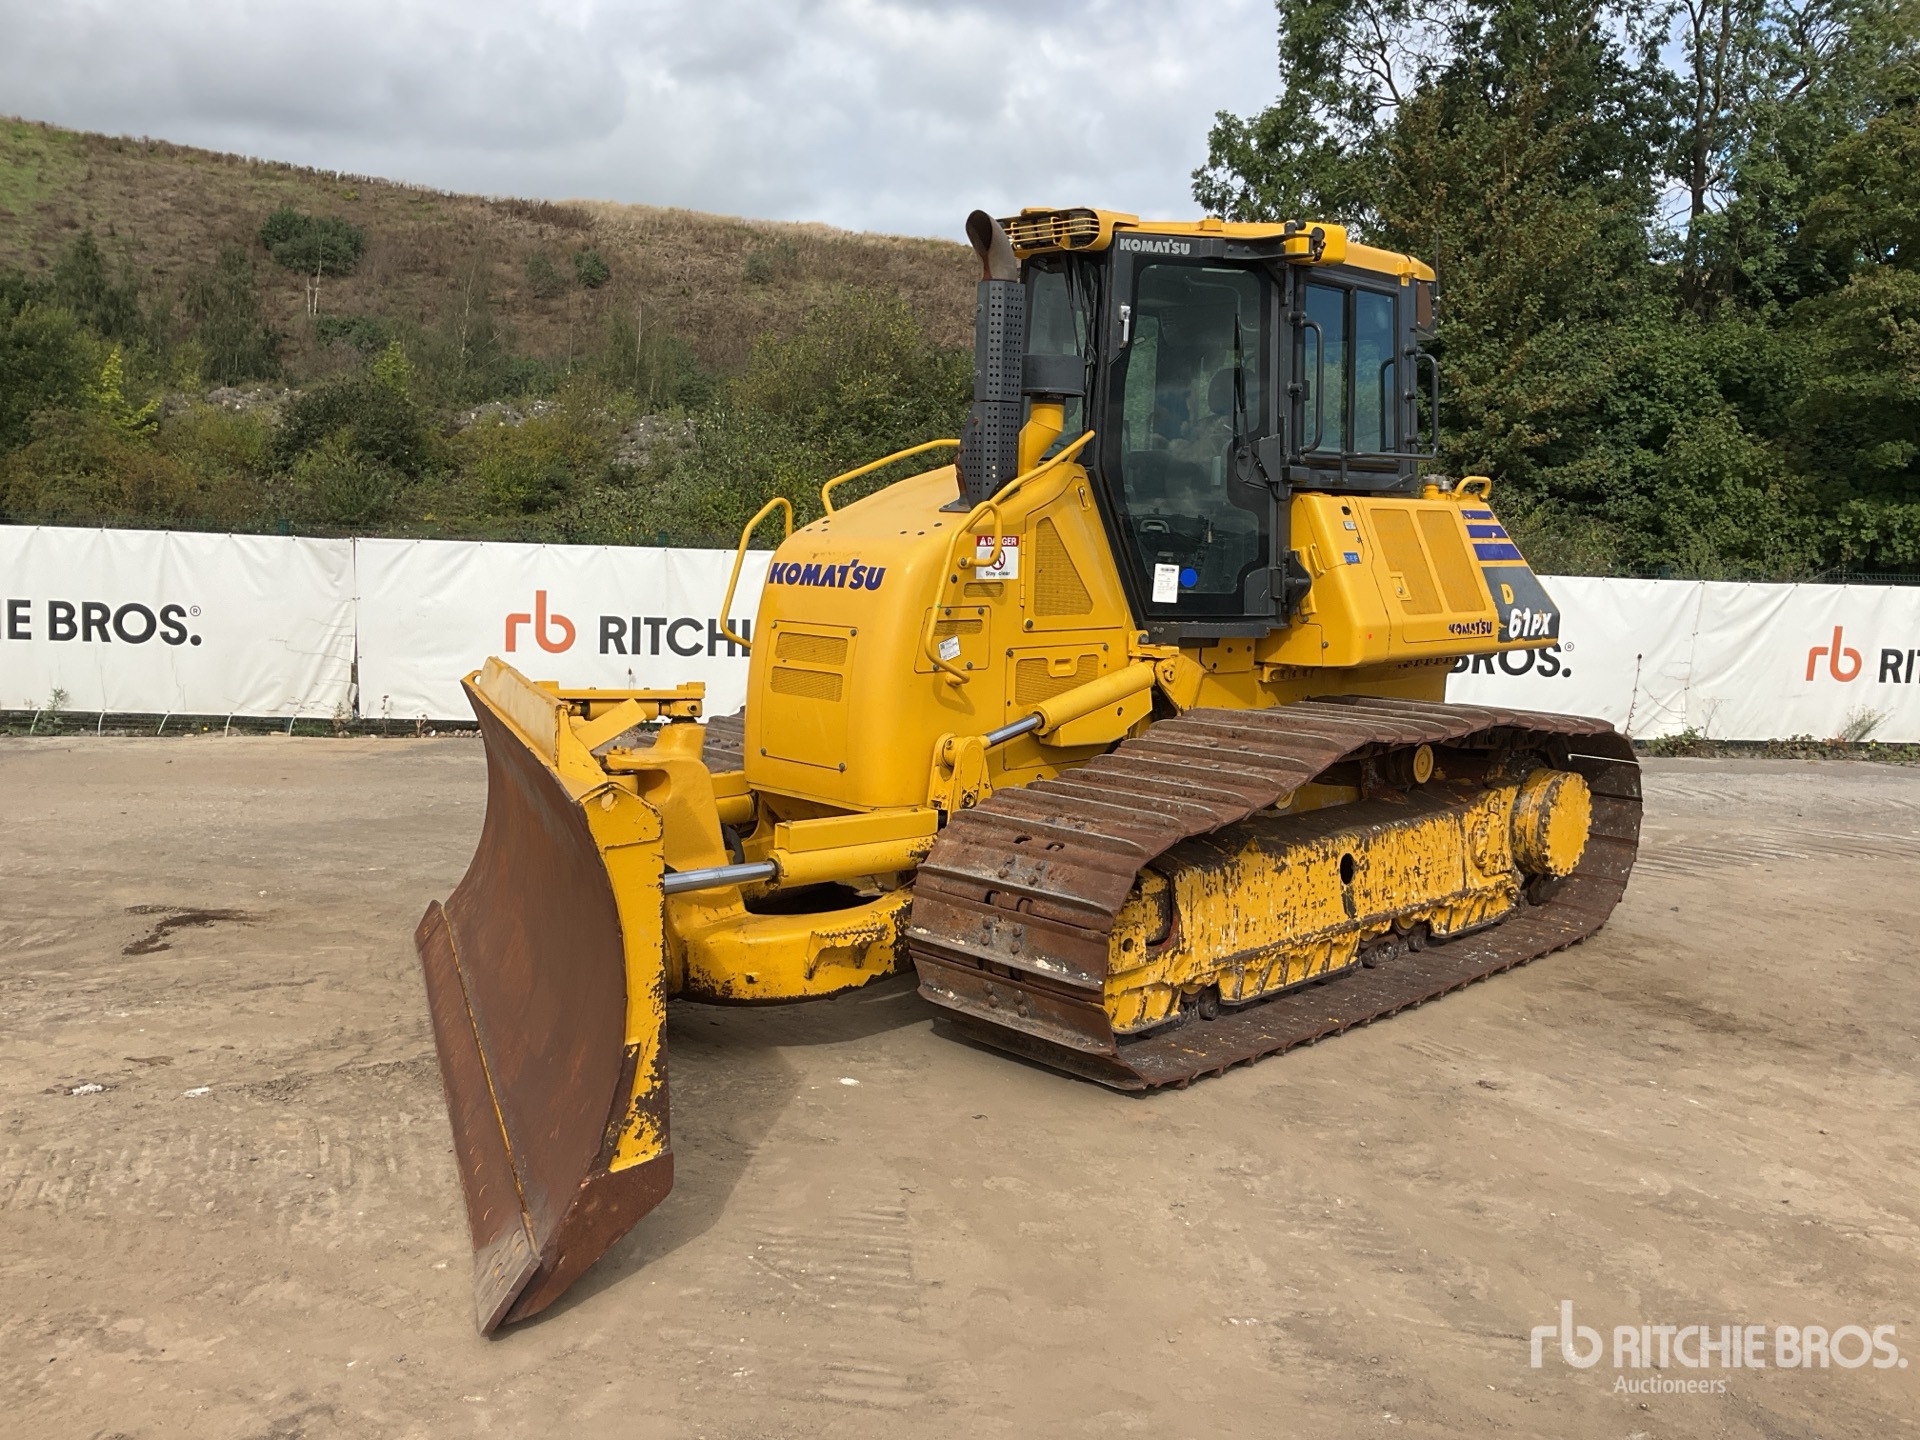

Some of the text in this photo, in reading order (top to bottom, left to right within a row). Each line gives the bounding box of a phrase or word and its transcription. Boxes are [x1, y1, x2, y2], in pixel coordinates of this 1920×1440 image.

[1119, 239, 1191, 255] KOMATSU
[987, 536, 1017, 546] DGER
[768, 559, 886, 591] KOMATSU
[1501, 583, 1514, 605] D
[48, 599, 202, 647] BROS.
[505, 590, 576, 654] rb
[1805, 625, 1920, 684] rb RI
